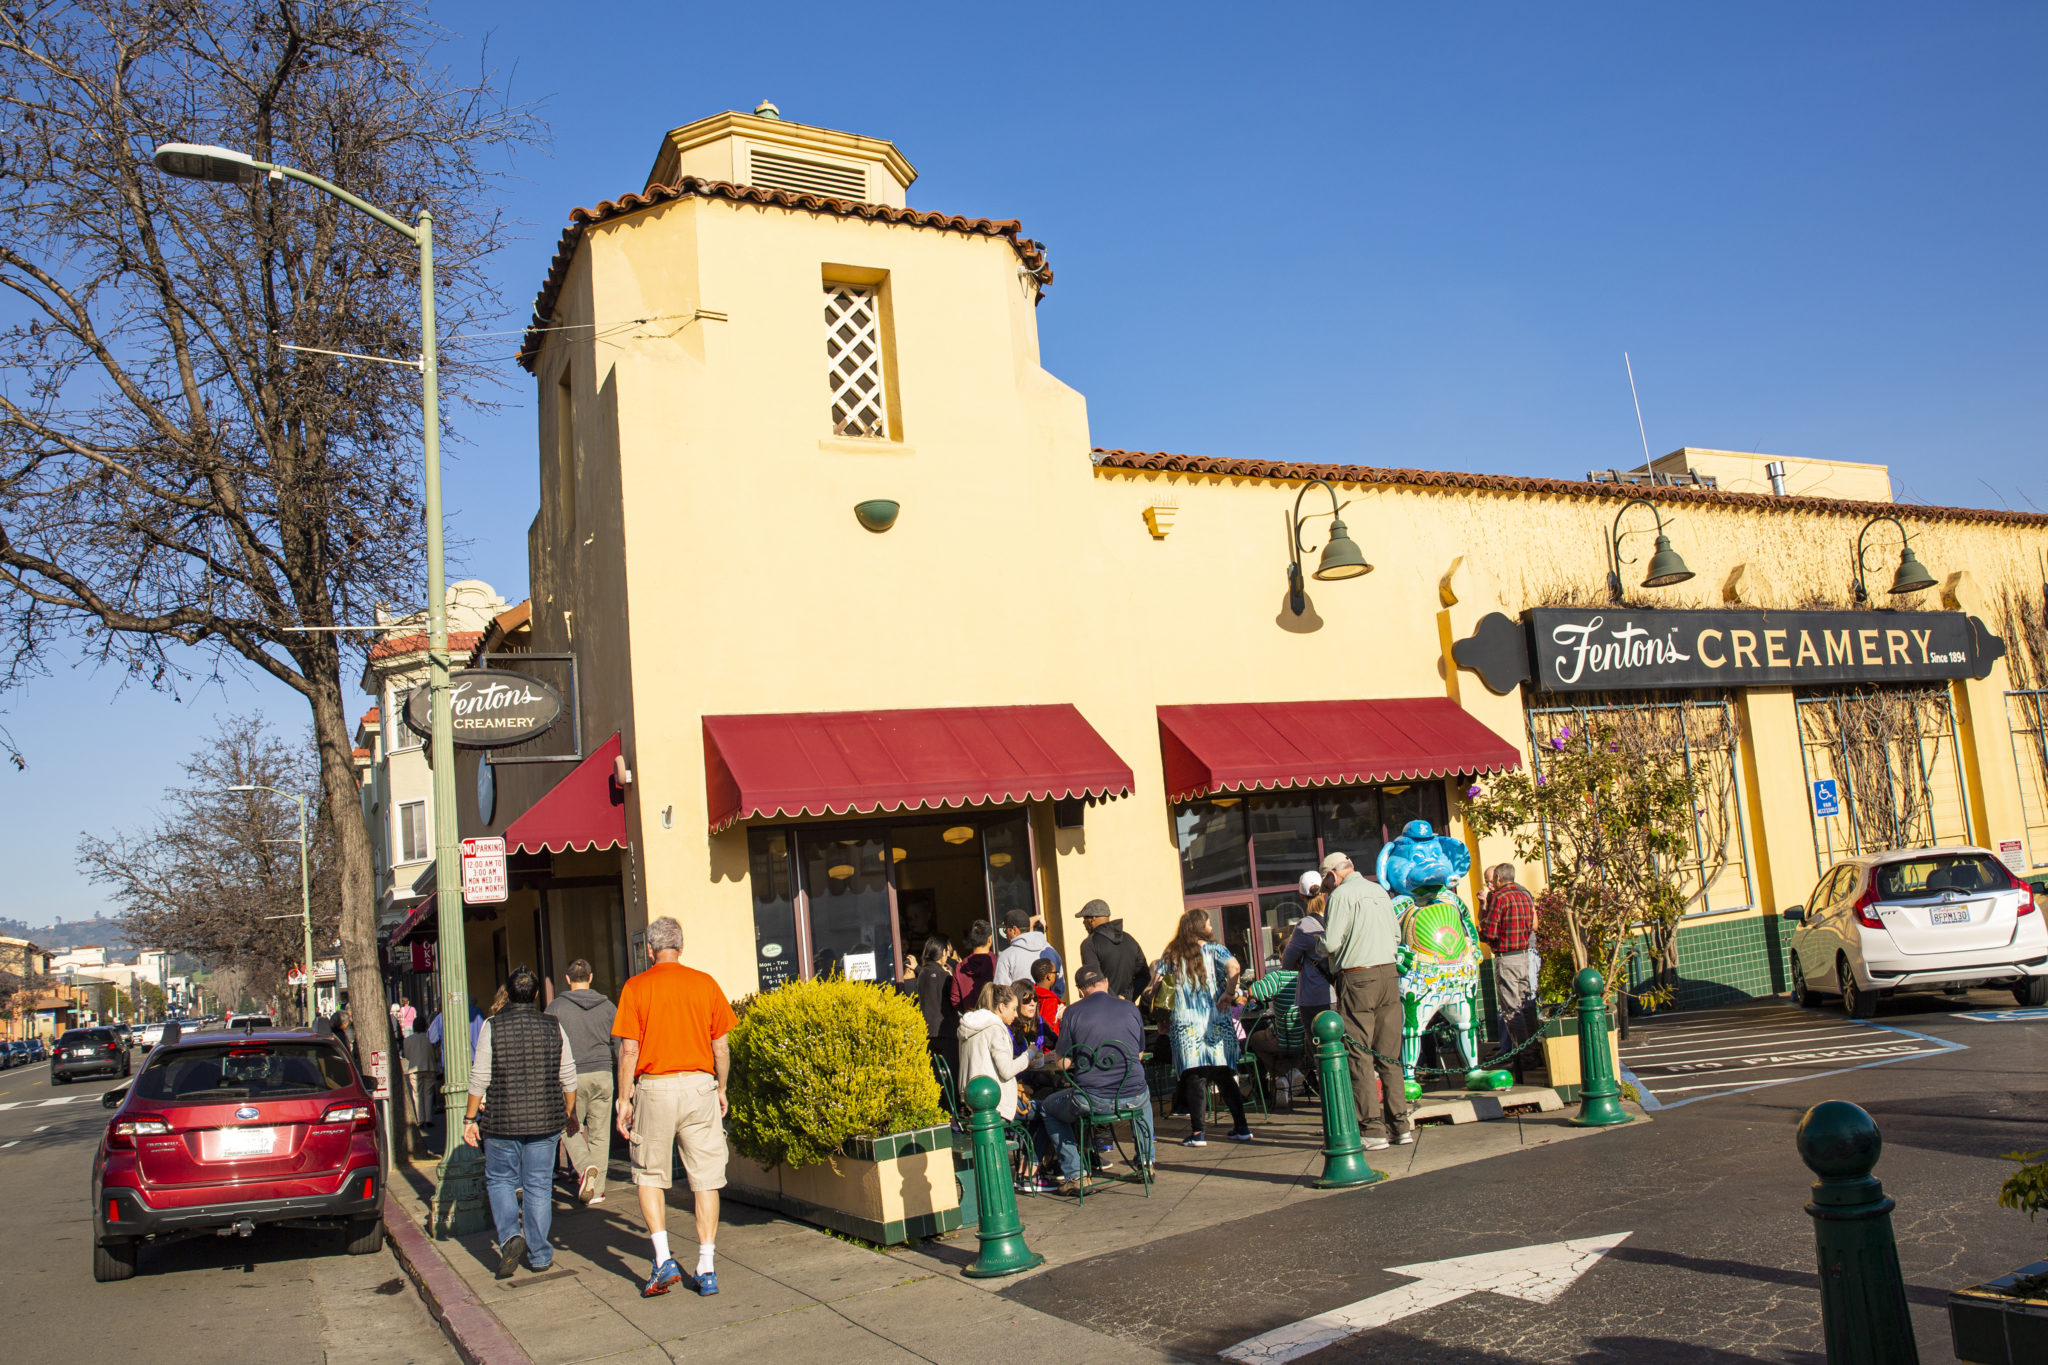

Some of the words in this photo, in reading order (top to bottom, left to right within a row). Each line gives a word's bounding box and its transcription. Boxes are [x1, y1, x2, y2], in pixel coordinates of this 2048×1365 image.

[1552, 615, 1691, 684] Fentons
[1696, 628, 1933, 669] CREAMERY
[1930, 652, 1948, 664] Since
[1948, 651, 1967, 663] 1894
[453, 718, 536, 728] CREAMERY
[464, 843, 476, 856] NO
[476, 844, 503, 852] PARKING
[1667, 1063, 1723, 1073] NO
[1741, 1045, 1921, 1065] PARKING
